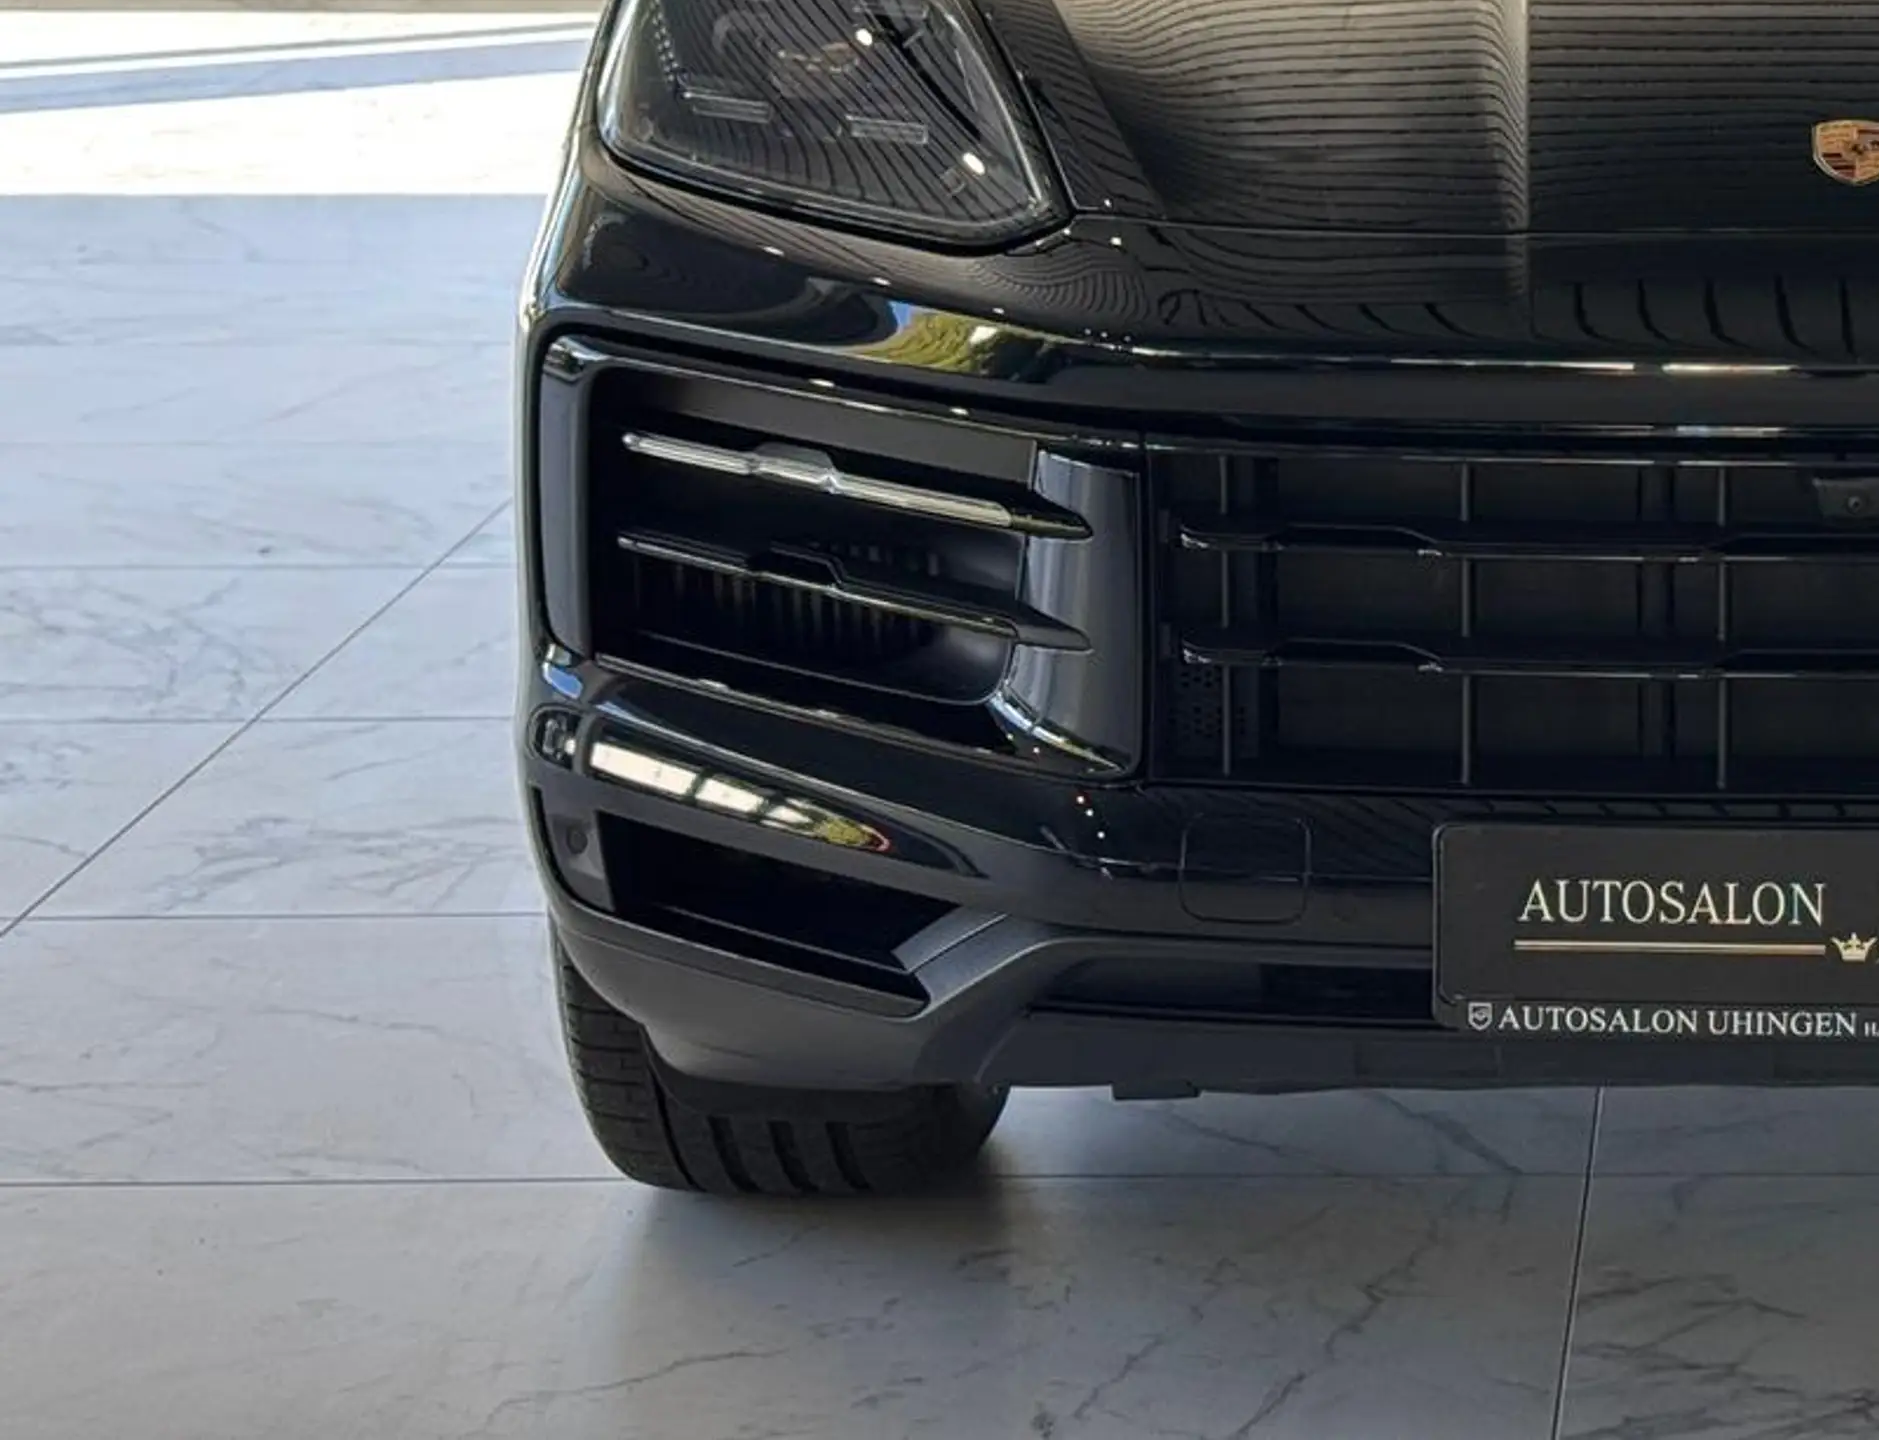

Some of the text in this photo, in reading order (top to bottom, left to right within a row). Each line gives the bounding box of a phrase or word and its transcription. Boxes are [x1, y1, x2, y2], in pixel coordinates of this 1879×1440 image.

[1517, 878, 1826, 927] AUTOSALON
[1498, 1005, 1698, 1034] AUTOSALON
[1706, 1009, 1858, 1037] UHINGEN
